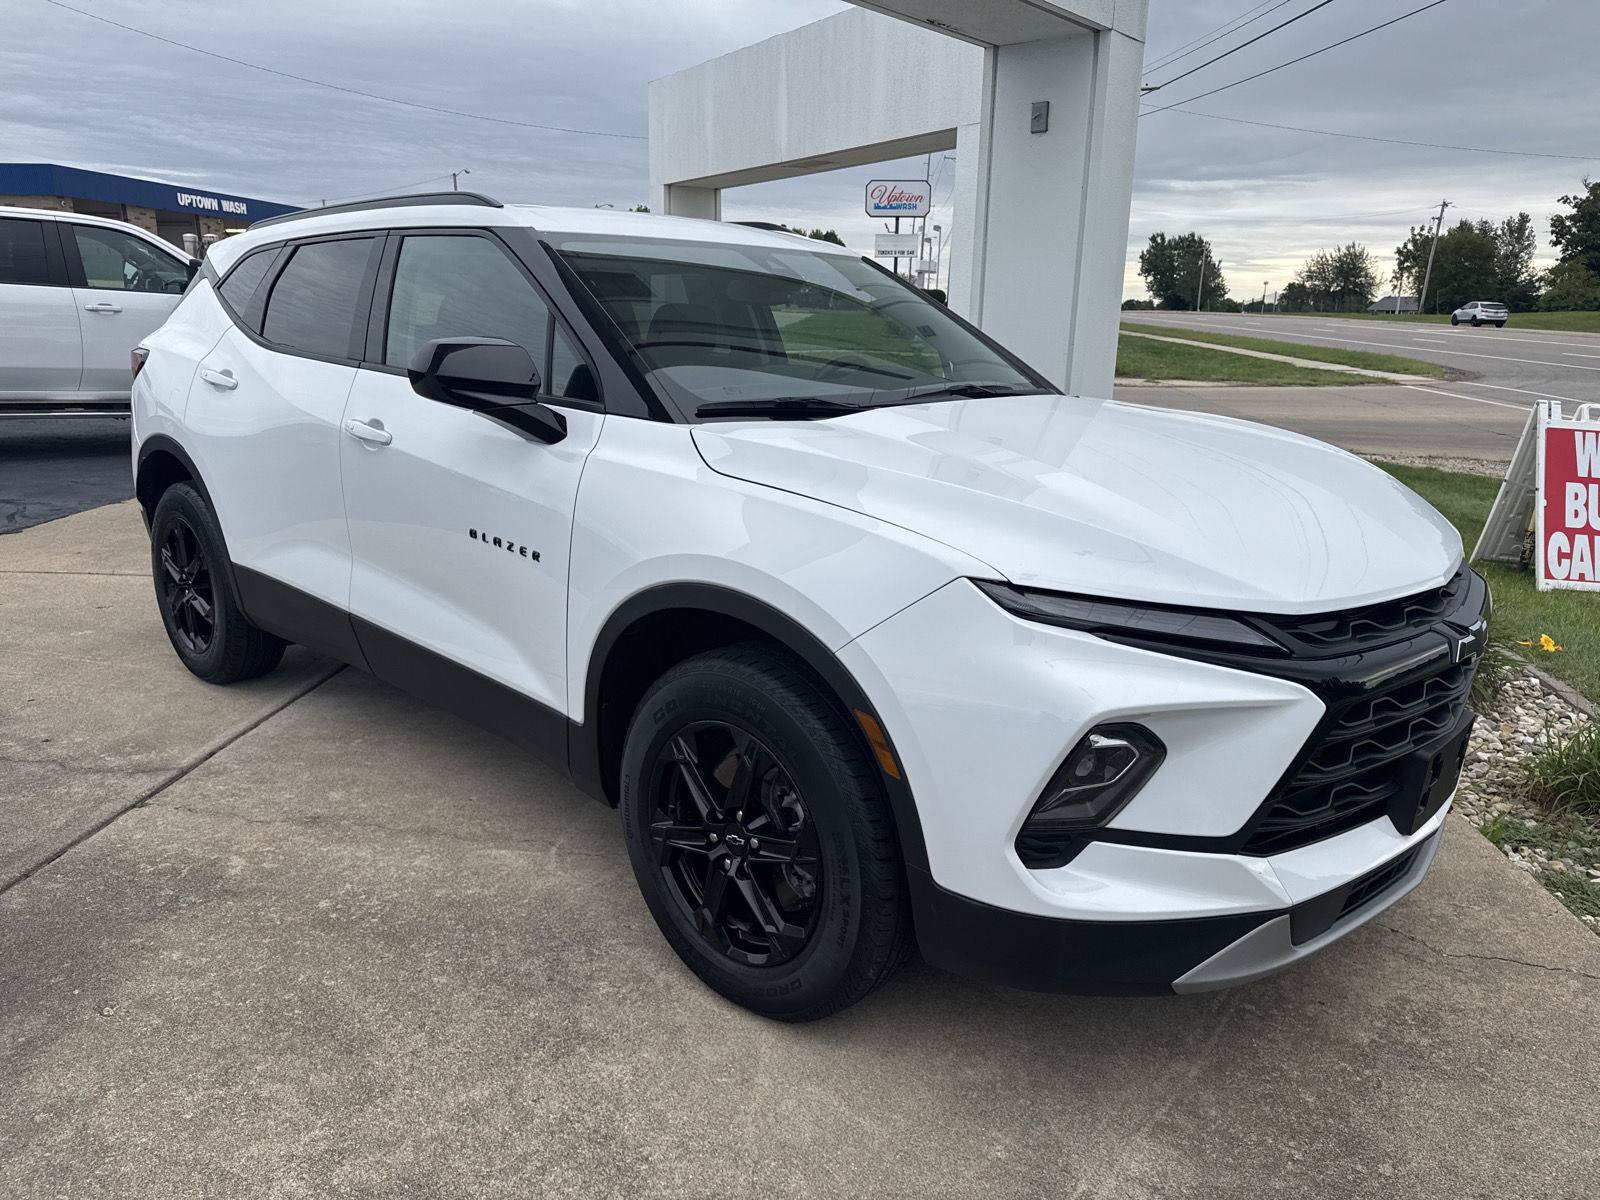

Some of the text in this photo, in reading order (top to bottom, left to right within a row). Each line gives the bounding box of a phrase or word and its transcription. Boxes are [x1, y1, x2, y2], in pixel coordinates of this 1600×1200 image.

[176, 192, 248, 215] UPTOWN WASH
[870, 184, 925, 204] Uptown
[897, 202, 918, 210] WASH
[469, 527, 541, 563] BLAZER
[1547, 531, 1600, 581] CA
